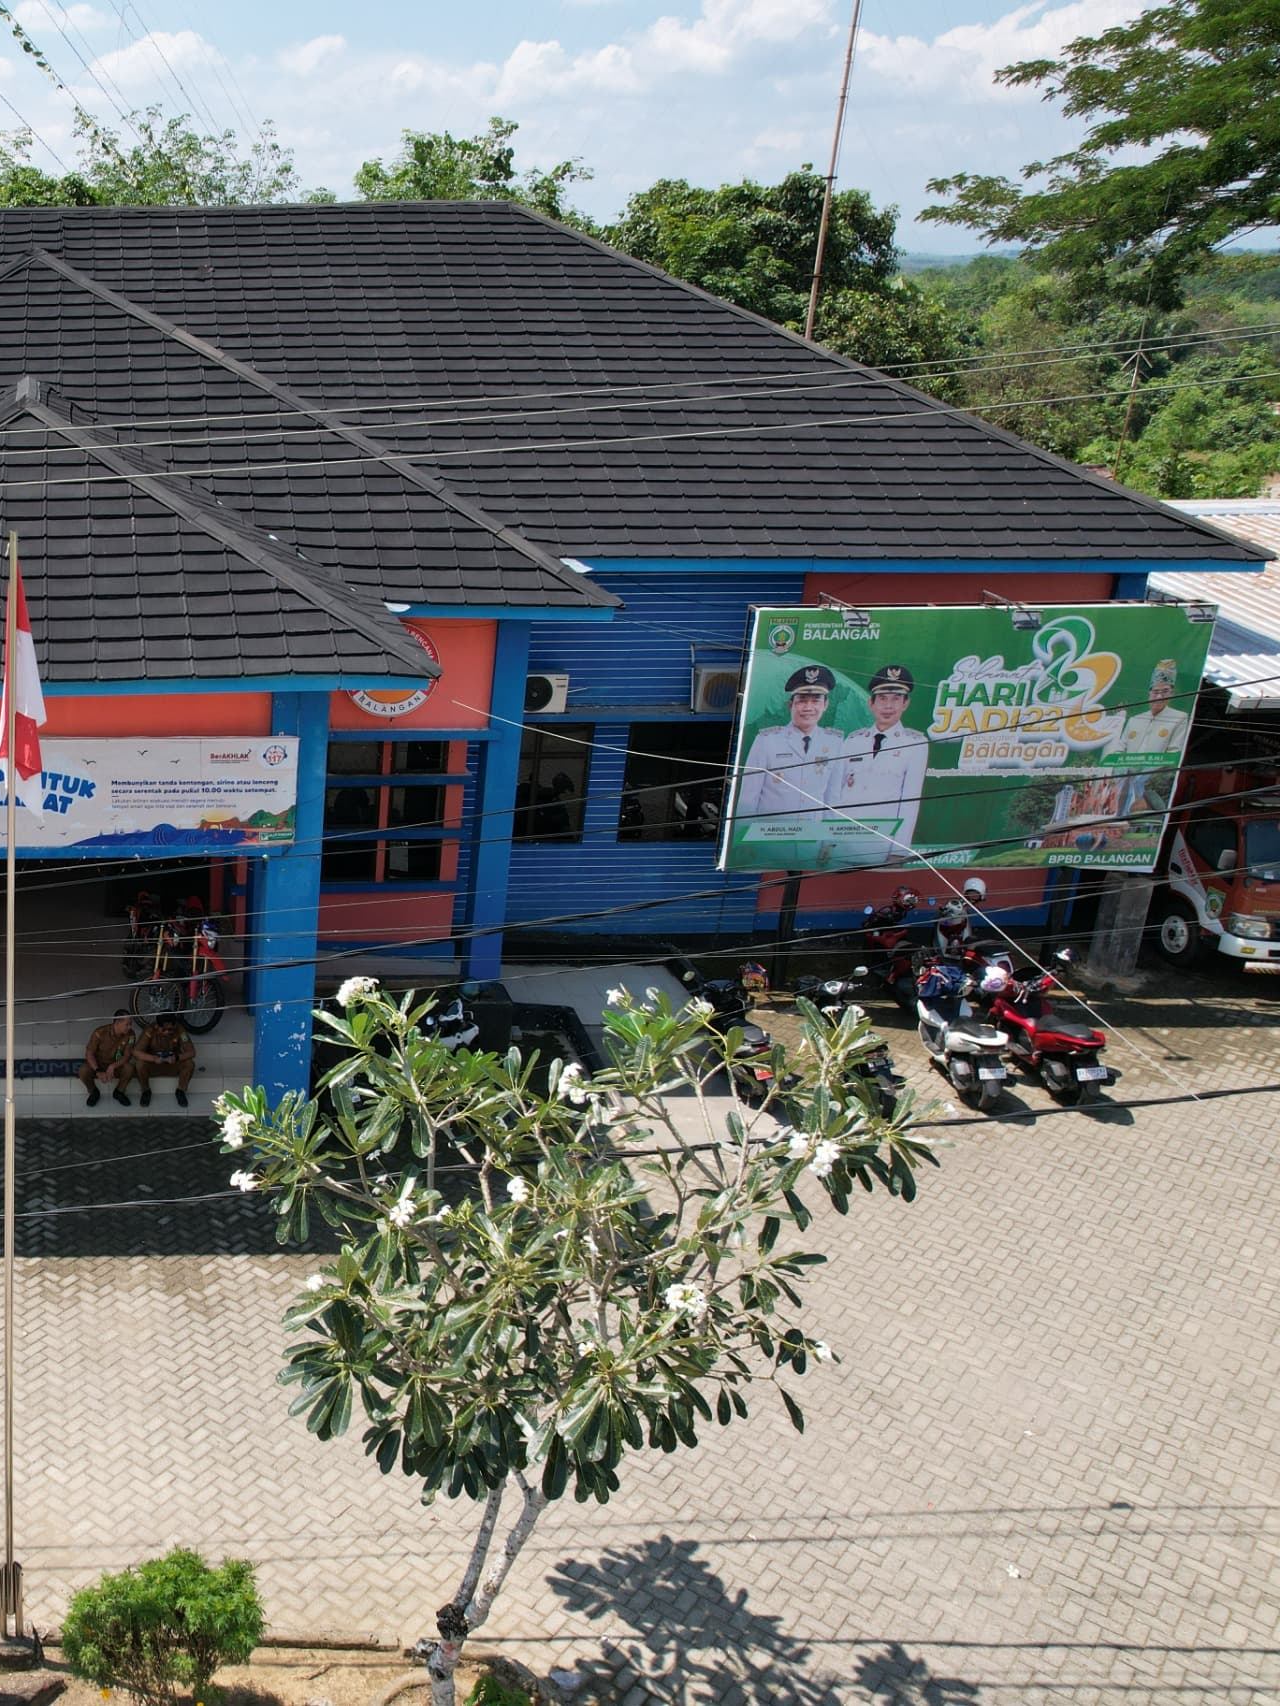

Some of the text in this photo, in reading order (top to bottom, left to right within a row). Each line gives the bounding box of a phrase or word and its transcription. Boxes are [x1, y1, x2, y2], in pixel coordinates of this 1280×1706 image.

[803, 629, 880, 640] BALANGAN
[358, 692, 422, 713] BALANGAN
[938, 682, 1028, 707] HARI
[932, 707, 1064, 733] JADI 22
[210, 751, 250, 759] BerAKHLAK
[1049, 853, 1152, 864] BPBD BALANGAN
